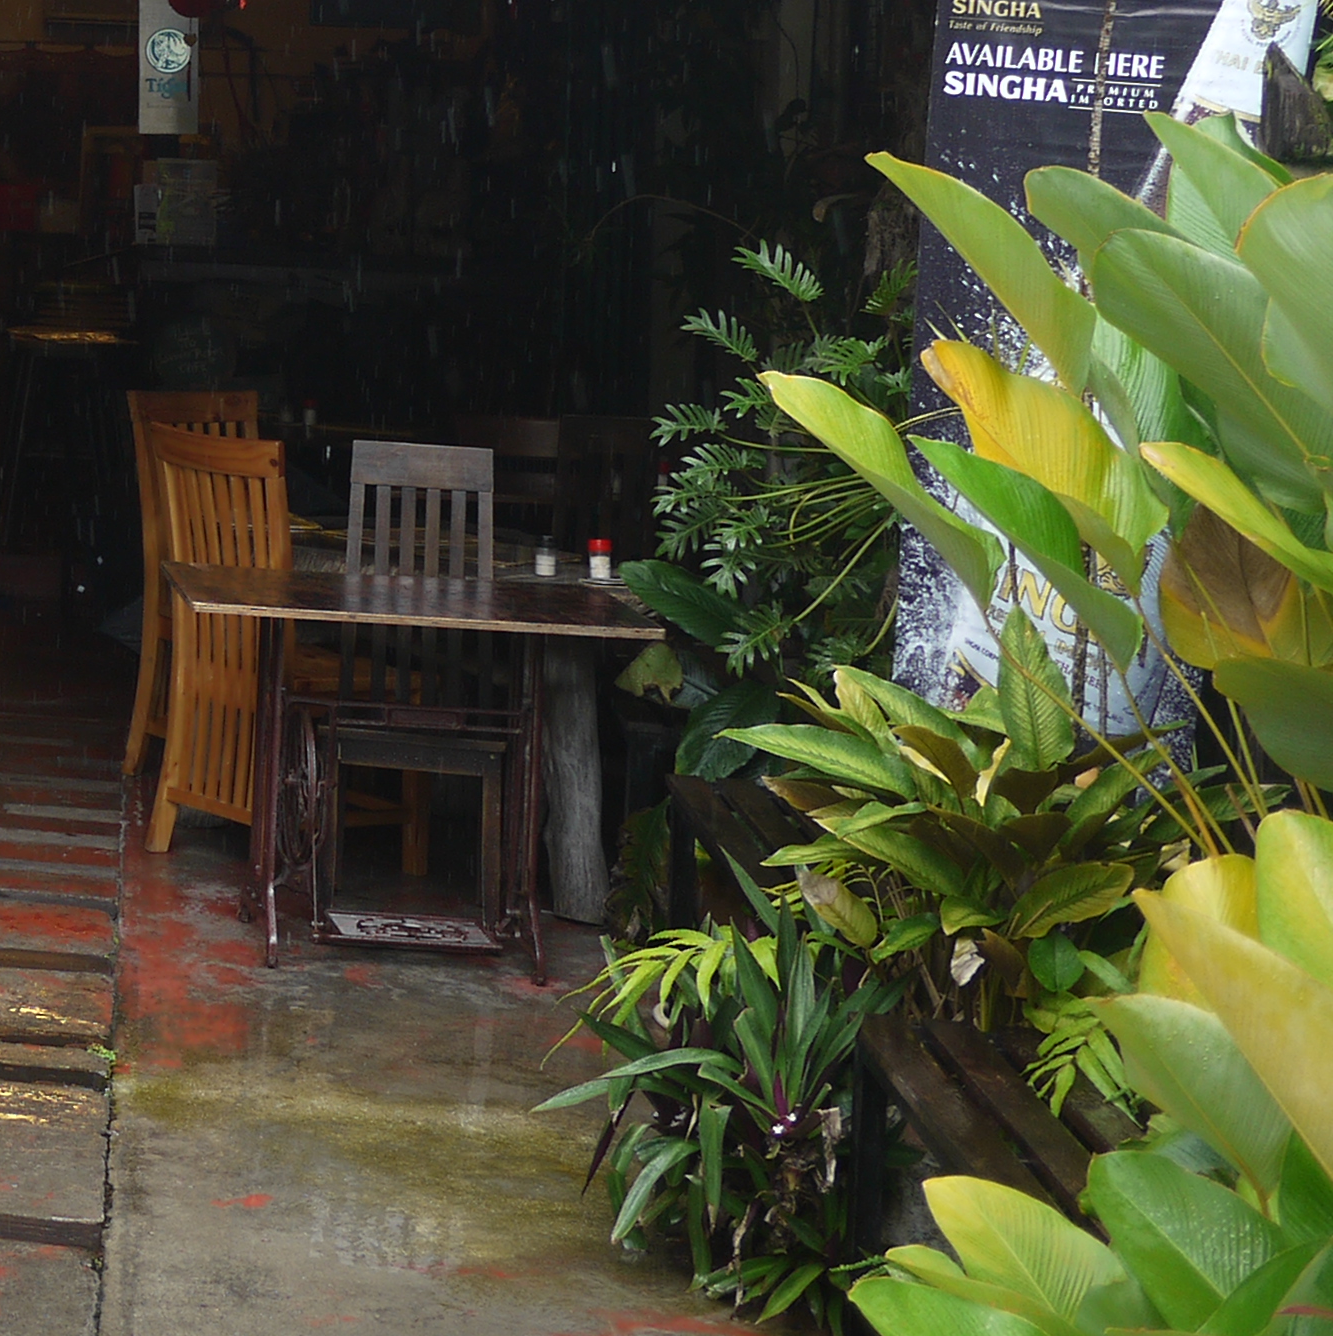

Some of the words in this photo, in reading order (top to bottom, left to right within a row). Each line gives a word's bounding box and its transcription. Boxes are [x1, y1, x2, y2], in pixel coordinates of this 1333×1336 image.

[949, 19, 971, 31] Taste
[976, 21, 987, 31] of
[989, 21, 1043, 37] Friendship
[945, 41, 1085, 74] AVAILABLE
[943, 70, 1069, 103] SINGHA
[1076, 84, 1155, 99] PRMIUM
[1070, 94, 1159, 110] IMORTED
